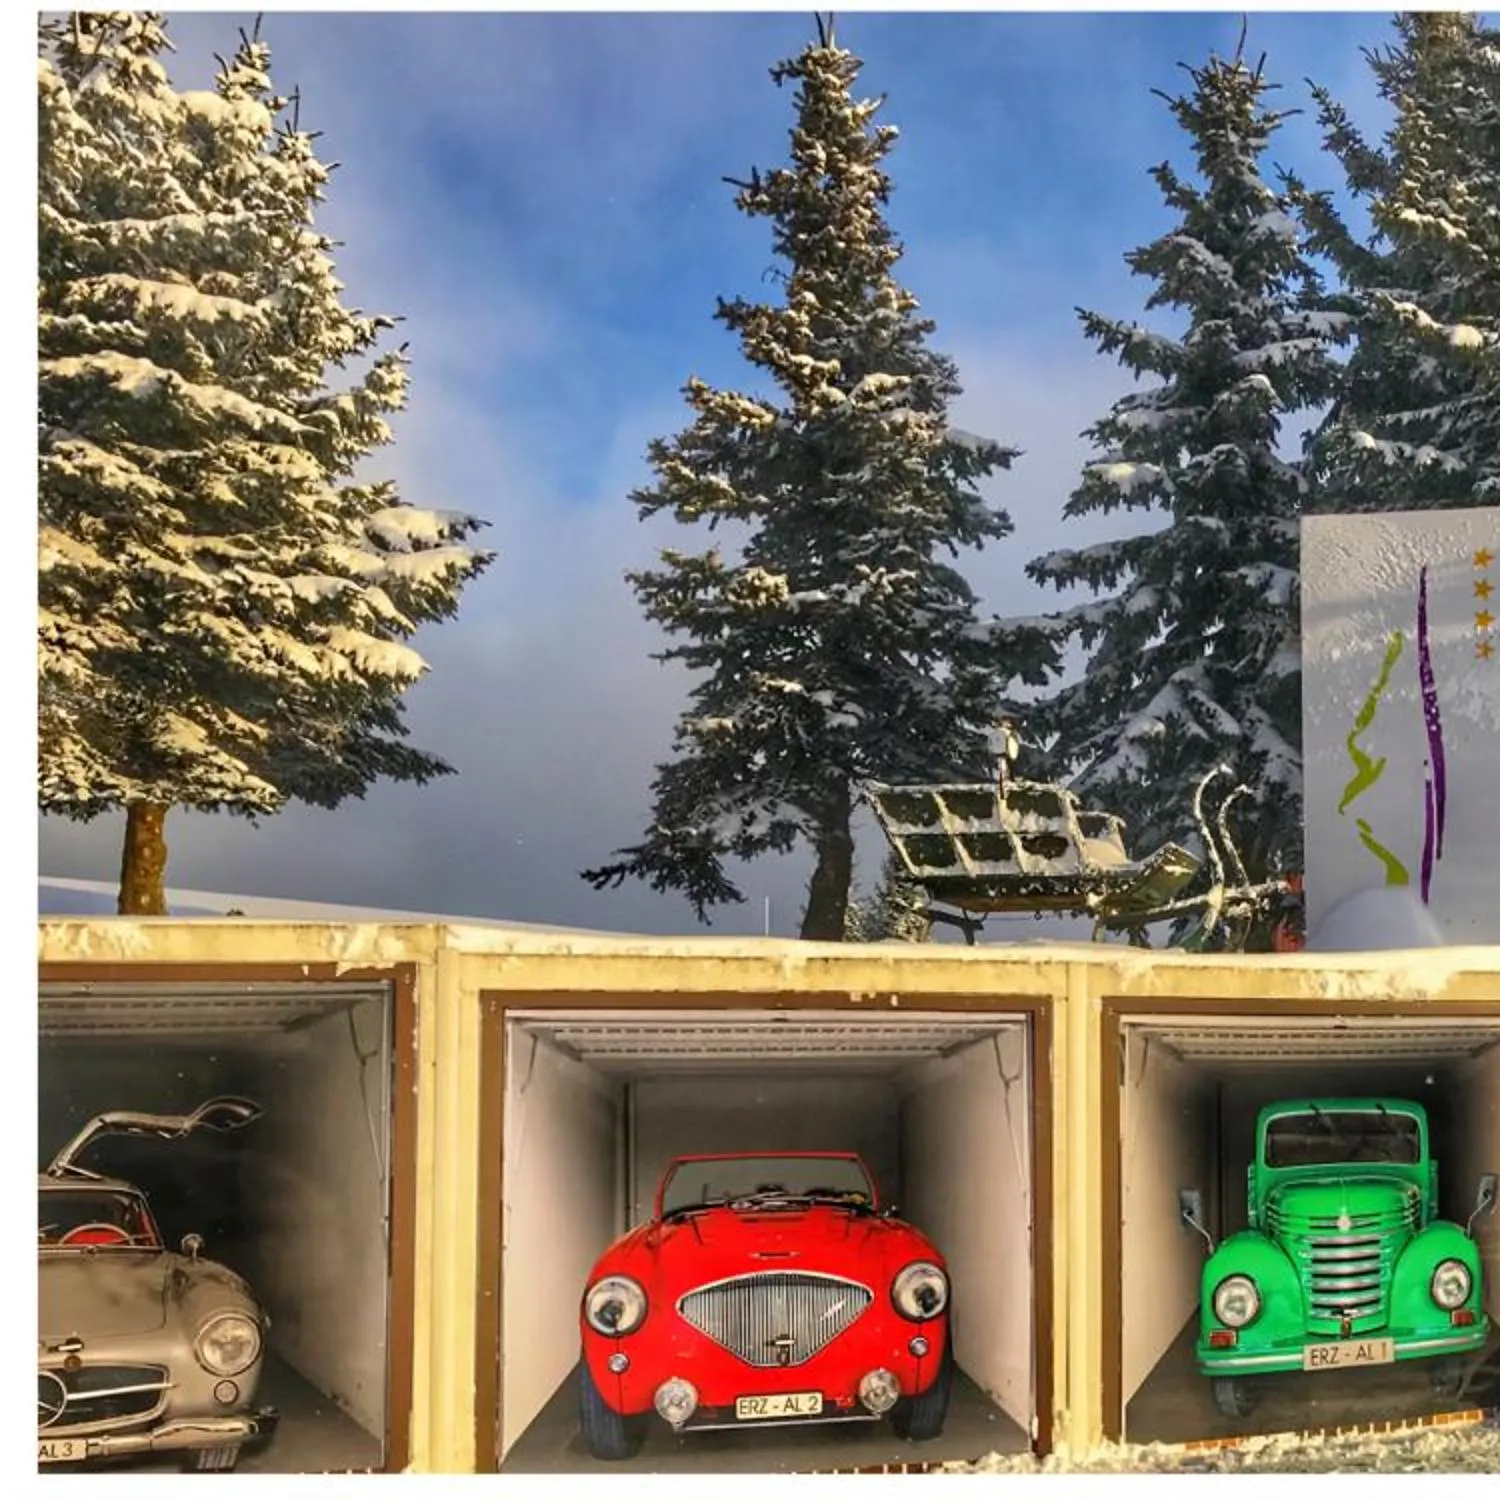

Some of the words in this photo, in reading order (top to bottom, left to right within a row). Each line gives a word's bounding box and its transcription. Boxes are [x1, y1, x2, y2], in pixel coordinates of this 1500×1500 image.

[1311, 1346, 1340, 1366] ERZ
[1356, 1343, 1374, 1361] AL
[739, 1397, 768, 1415] ERZ
[783, 1395, 802, 1413] AL
[808, 1395, 818, 1411] 2
[62, 1441, 73, 1457] 3
